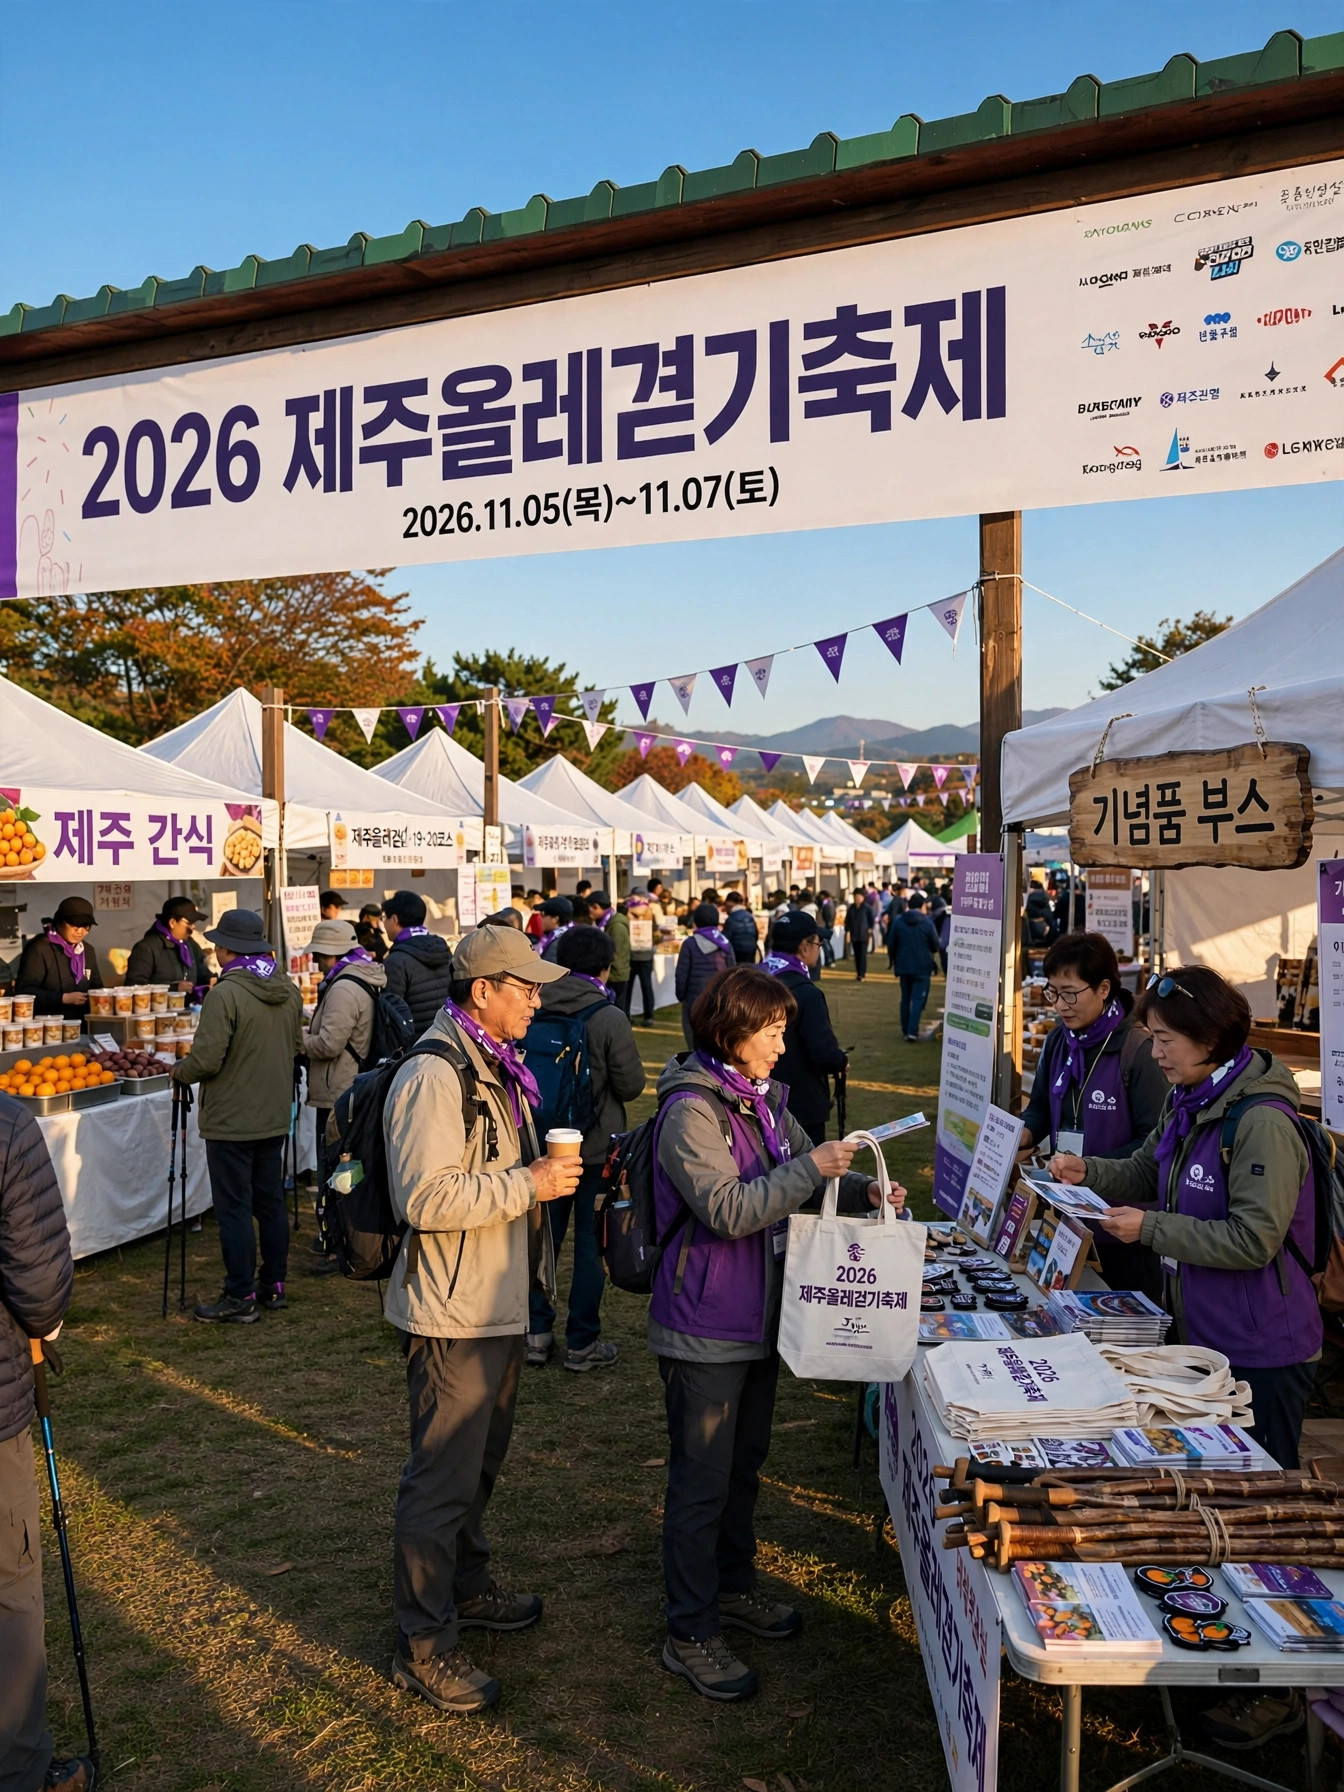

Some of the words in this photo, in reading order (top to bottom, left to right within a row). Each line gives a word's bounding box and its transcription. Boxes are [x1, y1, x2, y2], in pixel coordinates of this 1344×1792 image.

[82, 404, 261, 520] 2026
[402, 466, 780, 539] 2026.11.05(목)~11.07(토)
[53, 809, 135, 866] 제주
[148, 812, 214, 865] 간식
[1093, 781, 1187, 846] 기념품
[1197, 777, 1275, 845] 부스
[798, 1284, 908, 1310] 제주올레걷기축제
[836, 1265, 877, 1285] 2026
[1028, 1358, 1060, 1383] 2026
[911, 1409, 936, 1529] 2026
